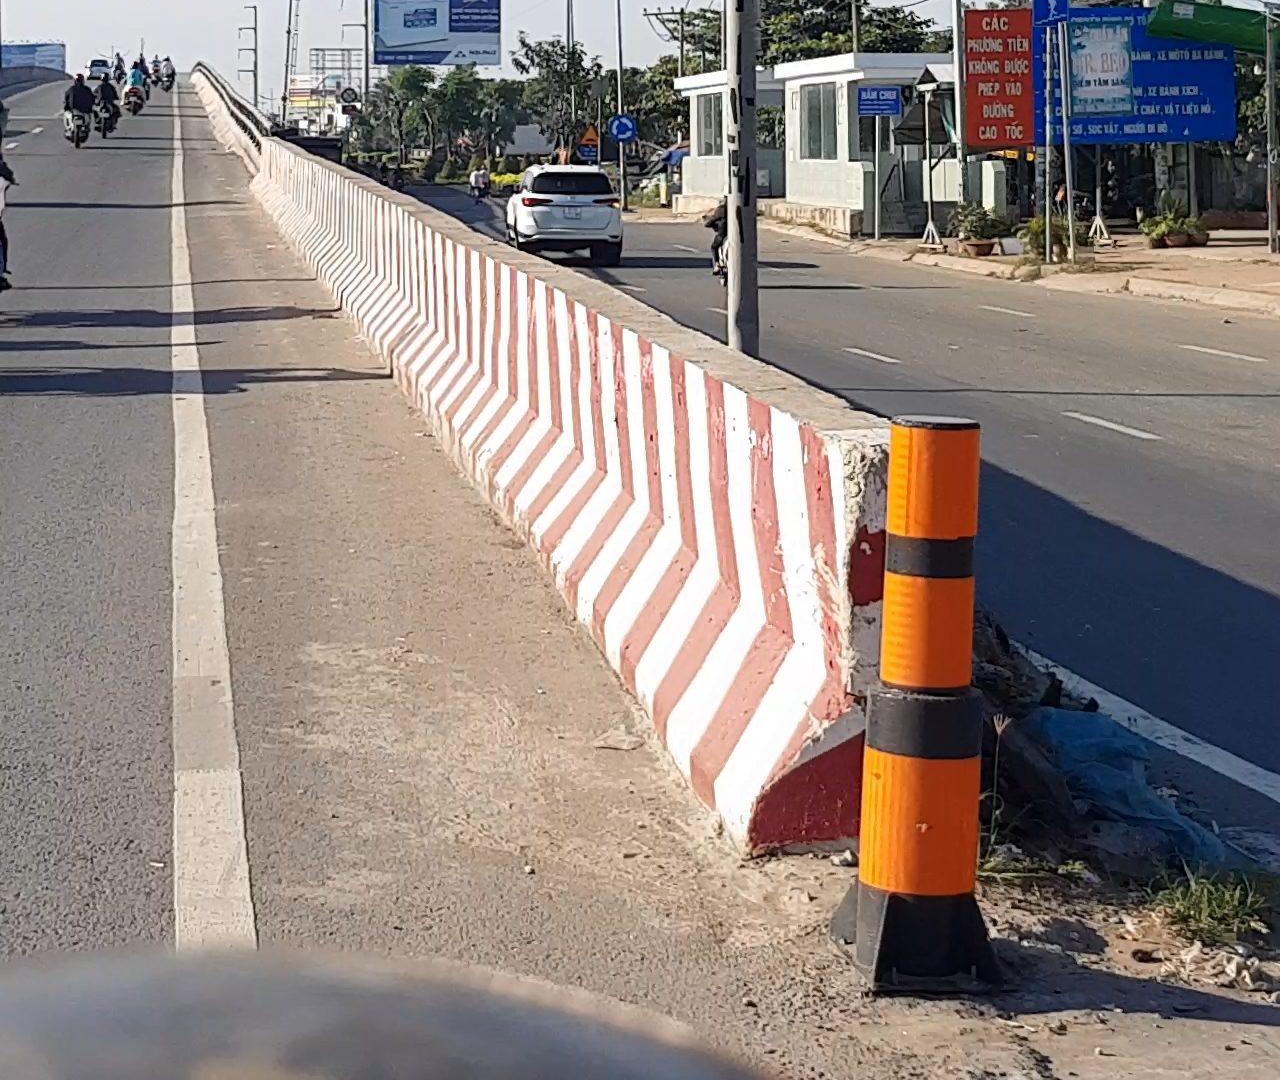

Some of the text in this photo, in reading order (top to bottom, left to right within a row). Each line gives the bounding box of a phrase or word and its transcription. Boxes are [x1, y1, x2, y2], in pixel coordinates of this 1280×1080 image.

[982, 13, 1009, 31] CÁC
[967, 36, 1003, 53] PHƯƠNG
[1007, 34, 1029, 56] TIỆN
[968, 56, 1000, 74] KHÔNG
[1004, 57, 1030, 78] ĐƯỢC
[978, 78, 1000, 96] PHÉP
[1005, 78, 1022, 96] VÀO
[983, 100, 1014, 118] ĐƯỜNG
[979, 125, 998, 140] CAO
[1005, 120, 1024, 140] TỐC
